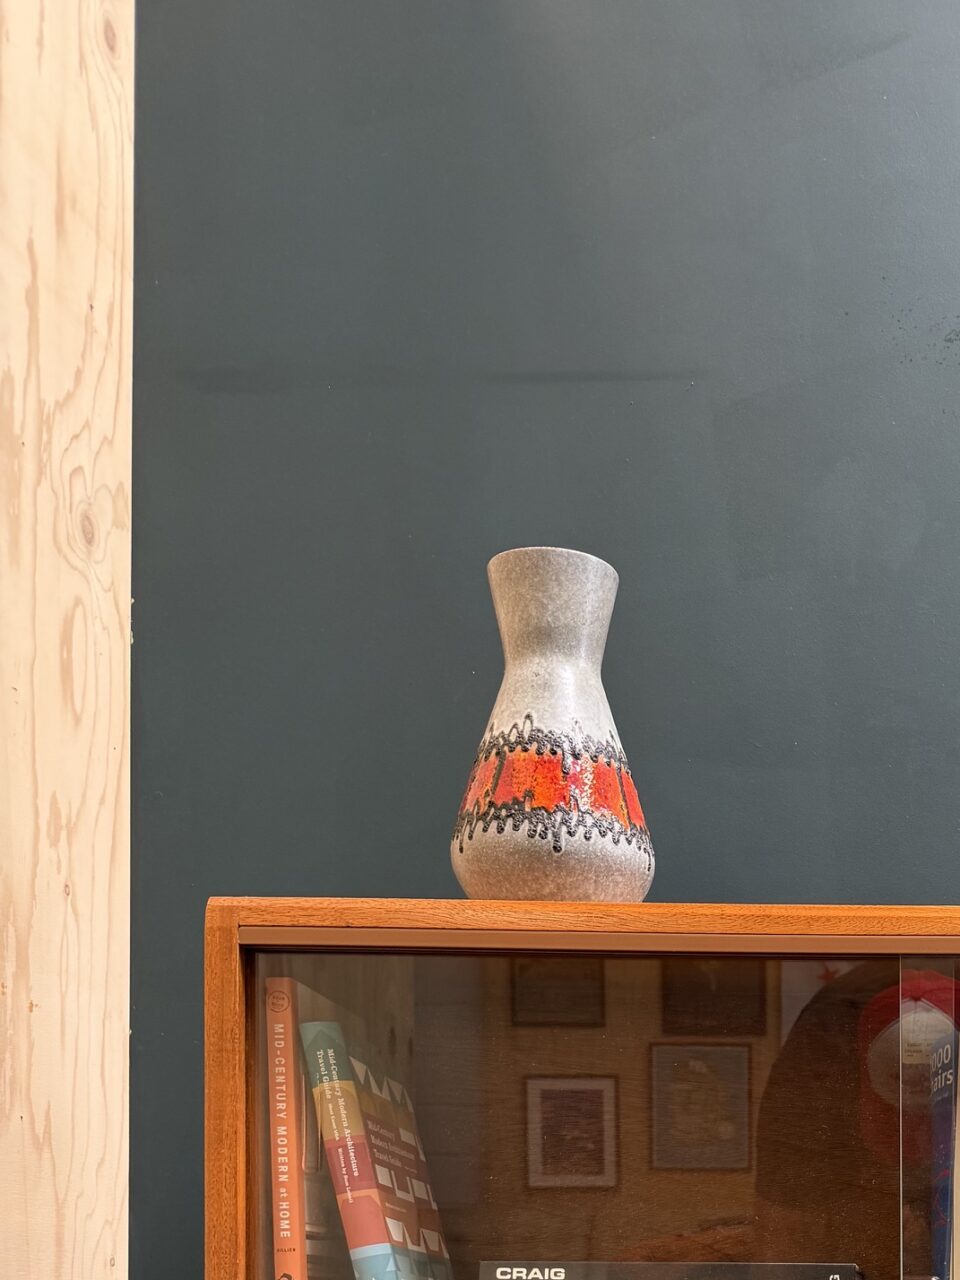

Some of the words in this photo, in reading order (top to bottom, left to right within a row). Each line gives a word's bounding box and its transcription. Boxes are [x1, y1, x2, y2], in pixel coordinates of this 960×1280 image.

[273, 1023, 287, 1119] MID-CENTURY
[316, 1049, 328, 1074] Travel
[322, 1076, 332, 1099] Guide
[277, 1125, 288, 1183] MODERN
[337, 1098, 349, 1127] Modern
[344, 1128, 360, 1177] Architecture
[279, 1187, 289, 1198] at
[279, 1202, 291, 1238] HOME
[496, 1267, 566, 1280] CRAIG
